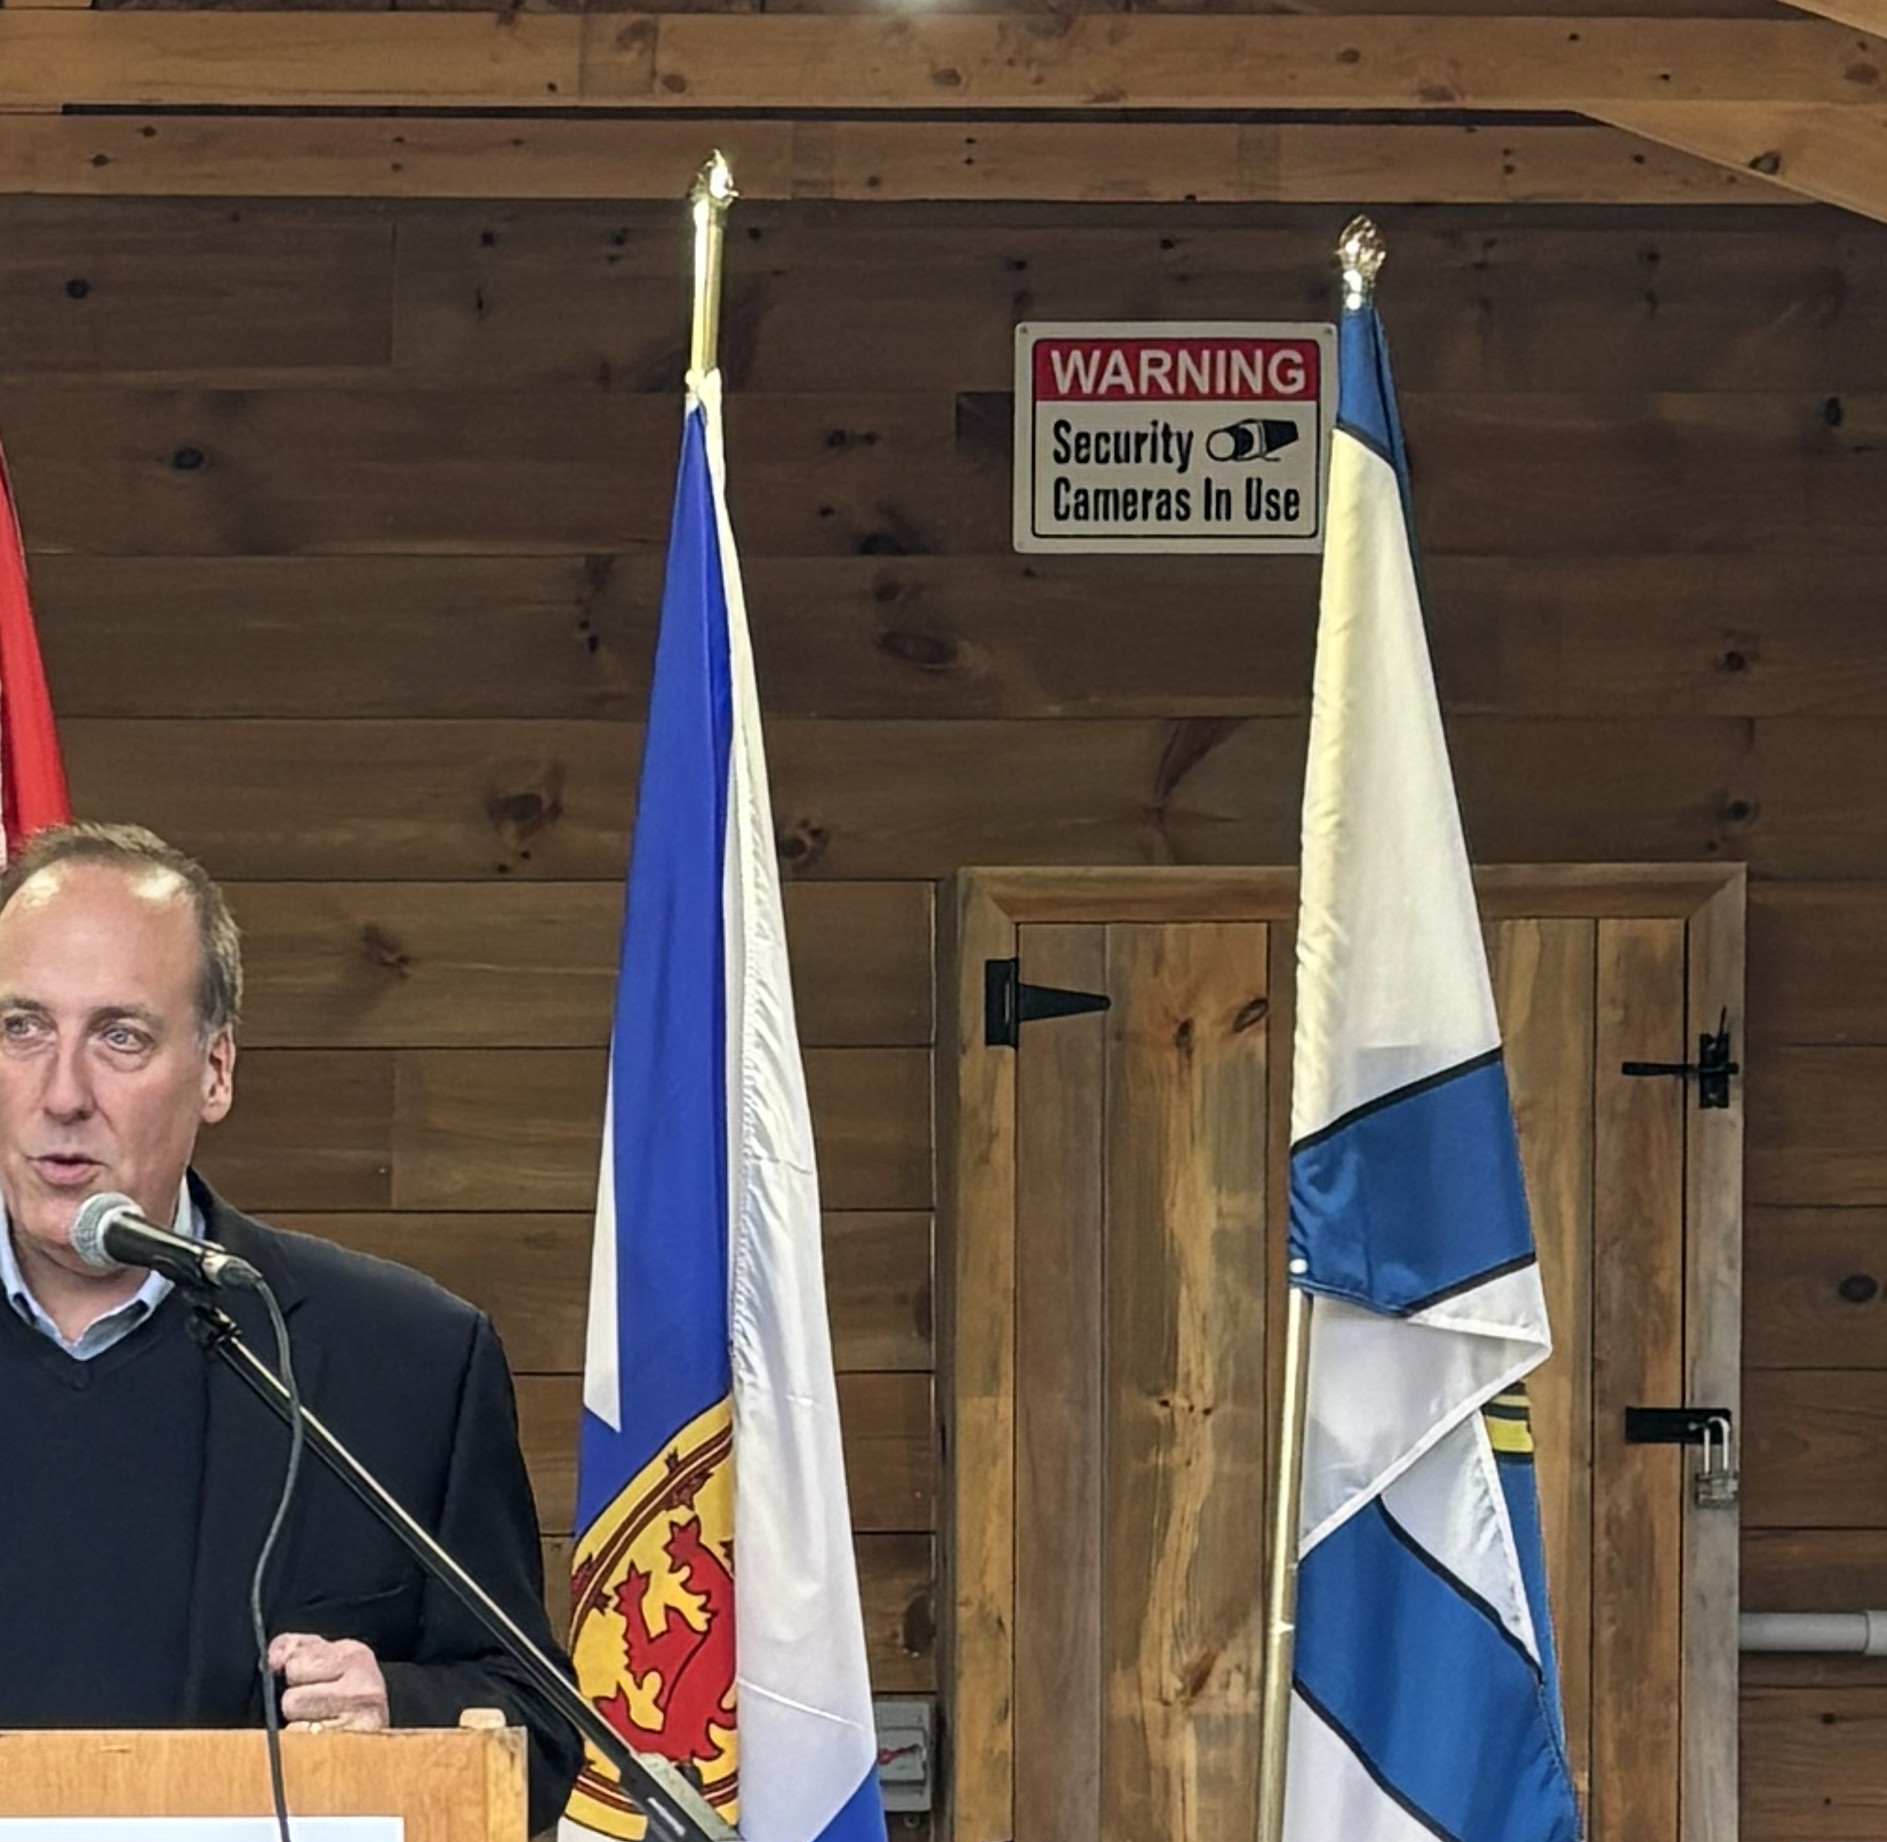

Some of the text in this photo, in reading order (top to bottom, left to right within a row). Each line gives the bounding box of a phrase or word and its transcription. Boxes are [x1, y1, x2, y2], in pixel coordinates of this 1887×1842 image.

[1050, 348, 1306, 395] WARNING
[1052, 418, 1194, 474] Security
[1053, 476, 1301, 522] Cameras In Use
